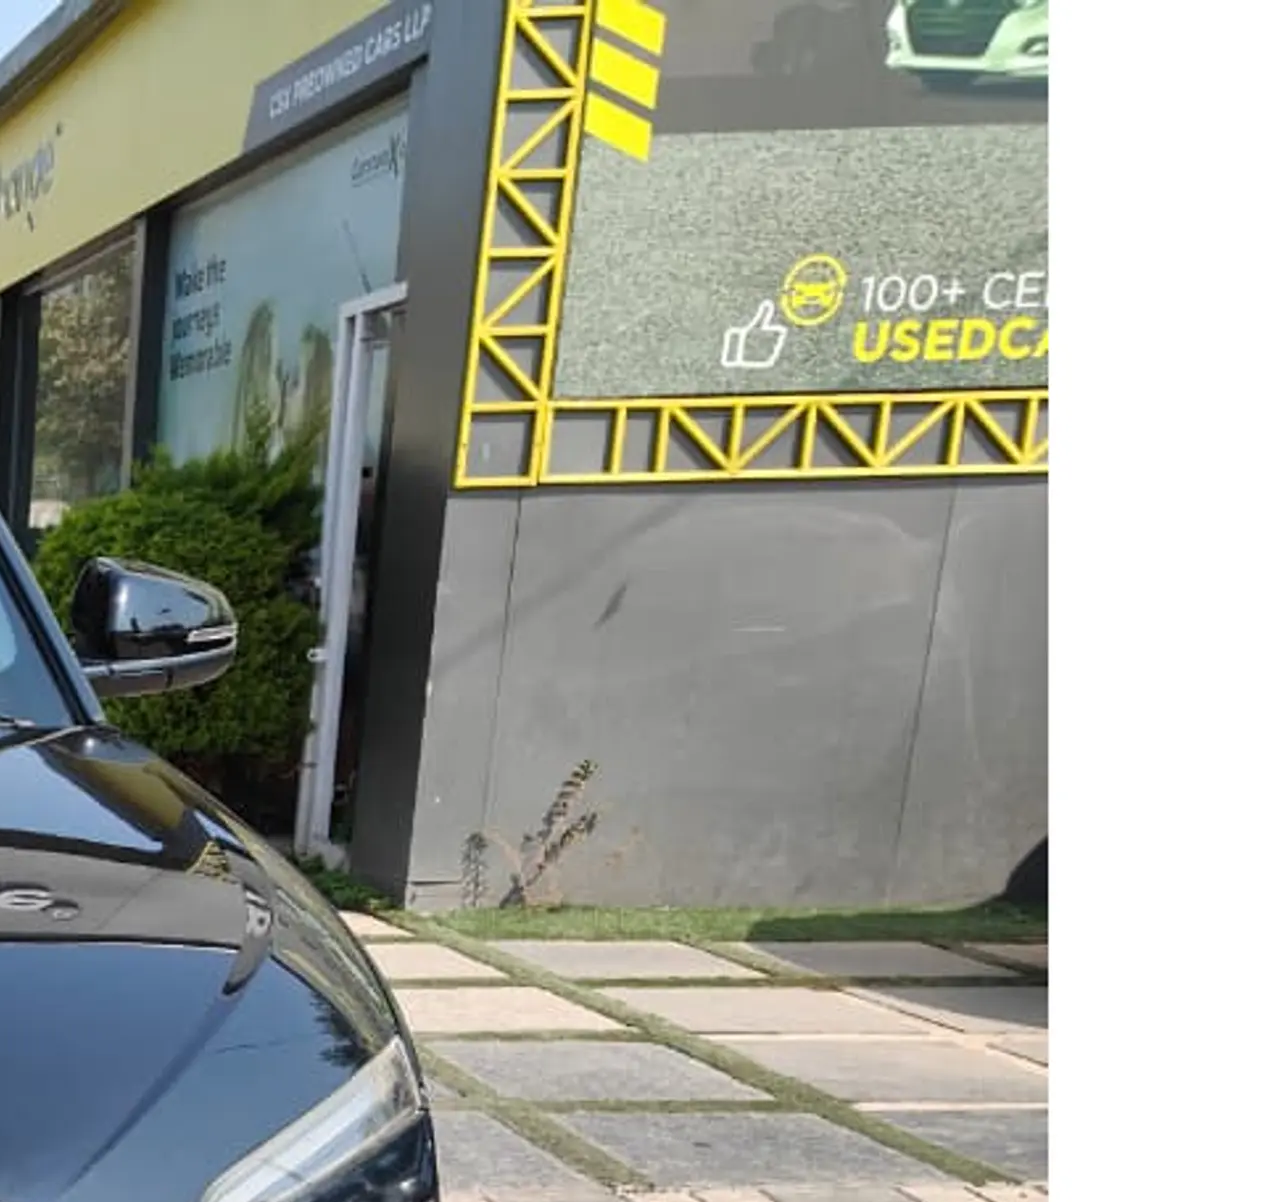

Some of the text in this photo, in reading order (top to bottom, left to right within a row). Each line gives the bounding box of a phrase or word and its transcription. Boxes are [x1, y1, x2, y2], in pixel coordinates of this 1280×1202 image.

[292, 44, 363, 106] PREOWNED
[365, 20, 402, 65] CARS
[404, 3, 432, 43] LLP
[861, 271, 1048, 312] 100+ CE
